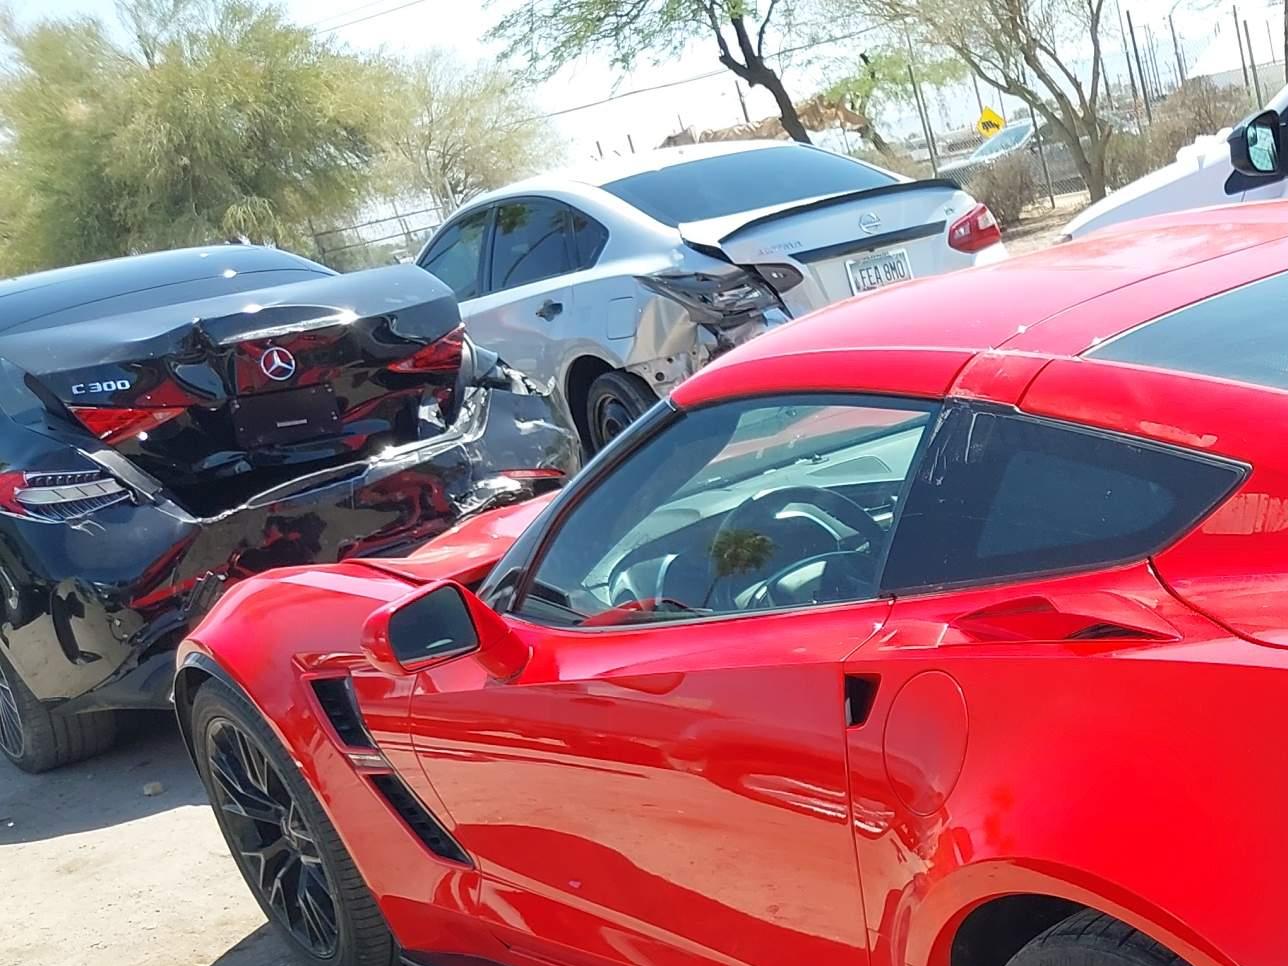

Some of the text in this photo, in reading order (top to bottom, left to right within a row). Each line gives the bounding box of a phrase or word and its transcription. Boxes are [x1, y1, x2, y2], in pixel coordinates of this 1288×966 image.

[859, 265, 883, 287] FEA
[71, 379, 131, 395] C 300
